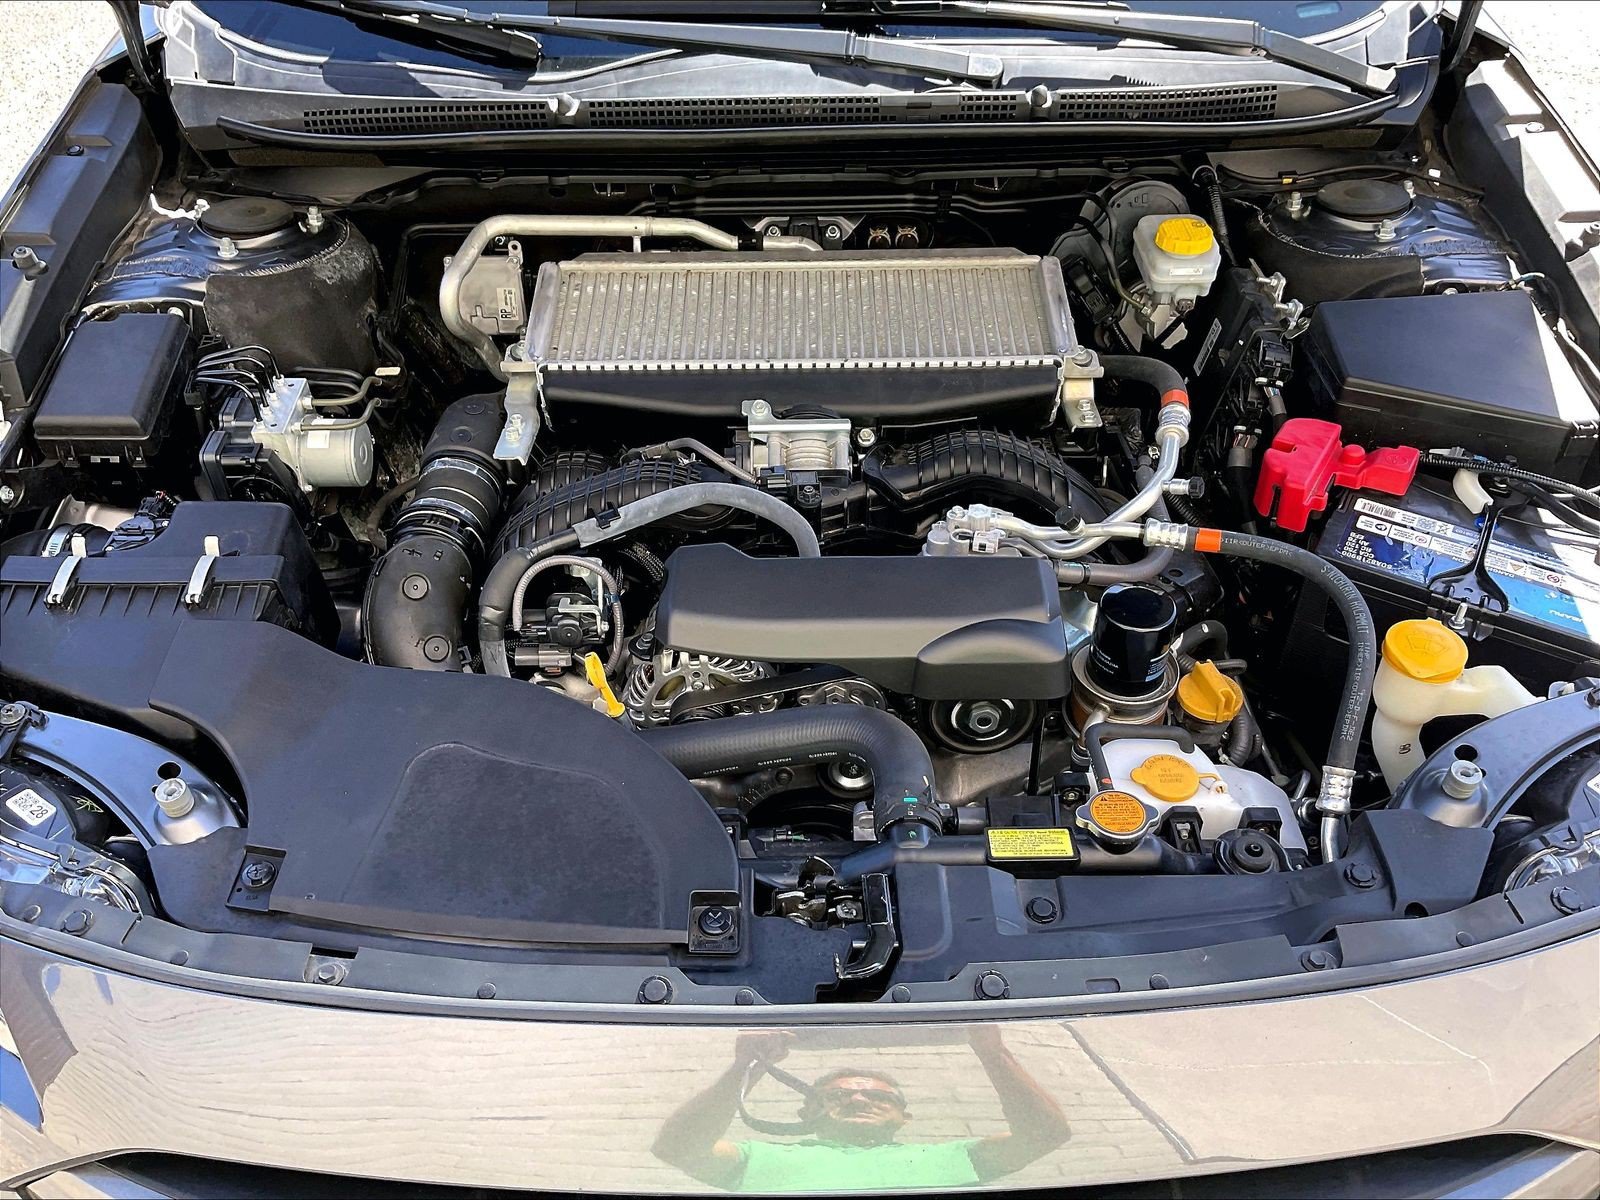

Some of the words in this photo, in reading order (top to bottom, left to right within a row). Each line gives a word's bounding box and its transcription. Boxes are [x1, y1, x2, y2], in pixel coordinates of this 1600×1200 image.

[500, 308, 511, 319] RP
[1343, 545, 1358, 554] 750
[1345, 541, 1360, 549] 120
[1360, 545, 1372, 553] RC
[1359, 550, 1375, 559] CCA
[30, 804, 49, 819] 28
